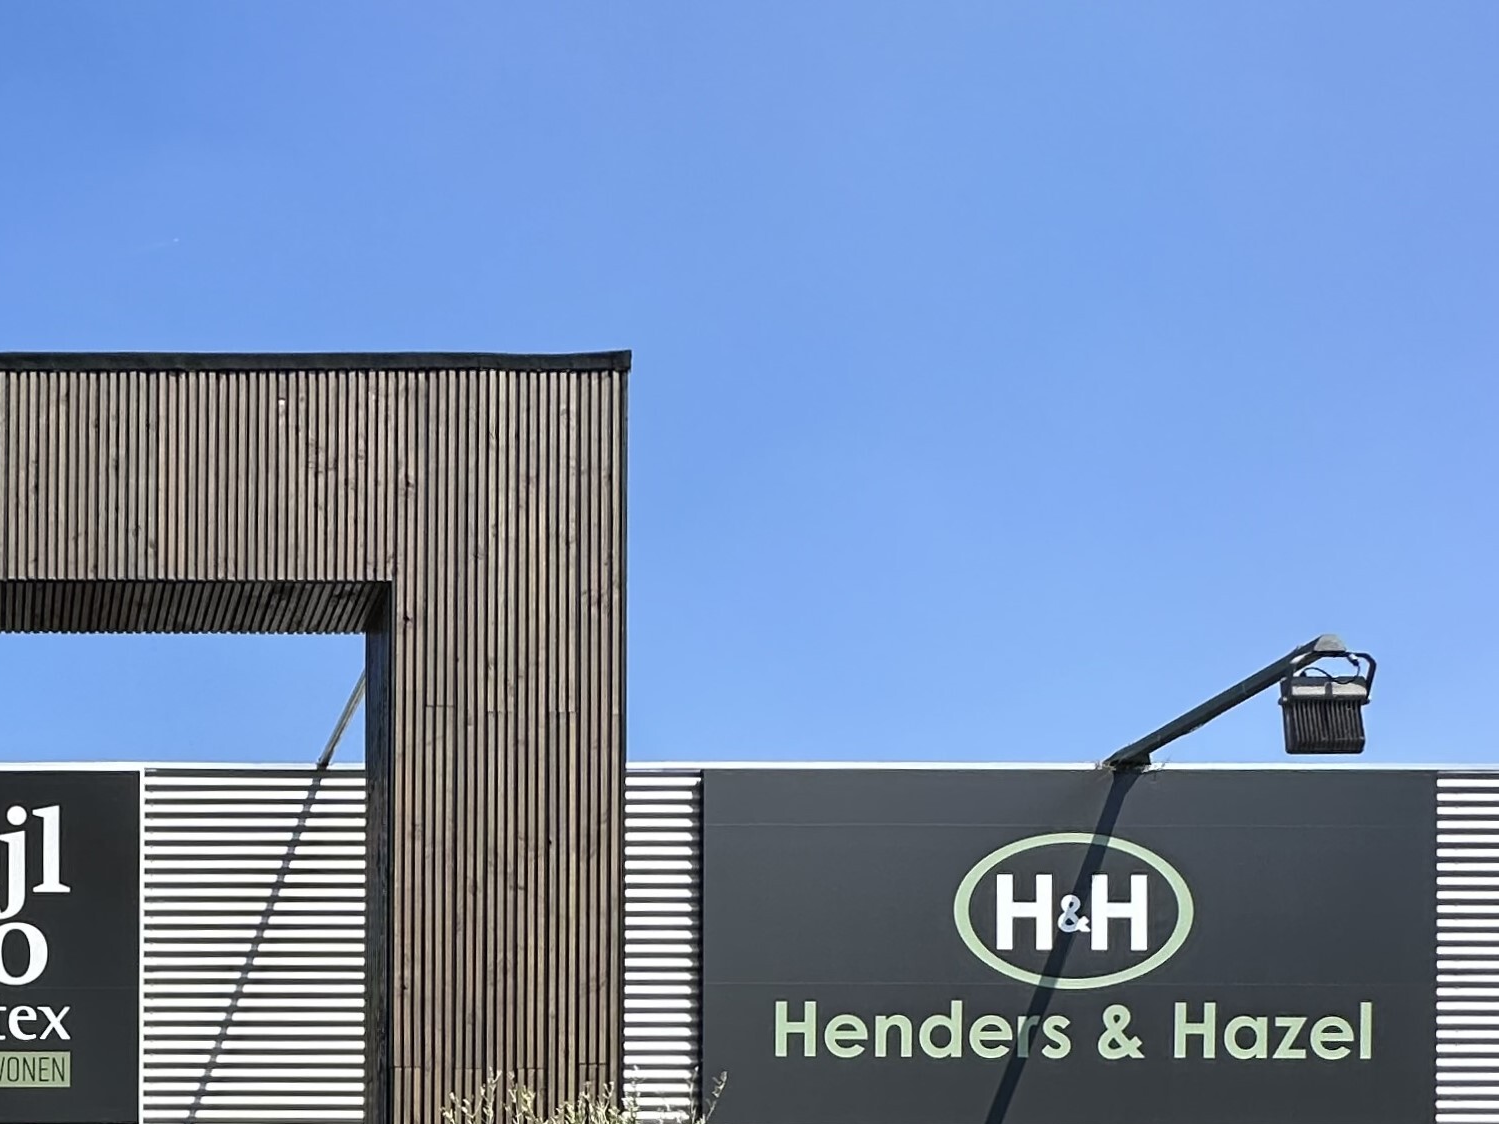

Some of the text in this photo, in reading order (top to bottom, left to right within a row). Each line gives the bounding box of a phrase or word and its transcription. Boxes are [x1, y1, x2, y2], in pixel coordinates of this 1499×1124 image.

[995, 872, 1148, 952] H&H
[774, 999, 1371, 1061] Henders & Hazel
